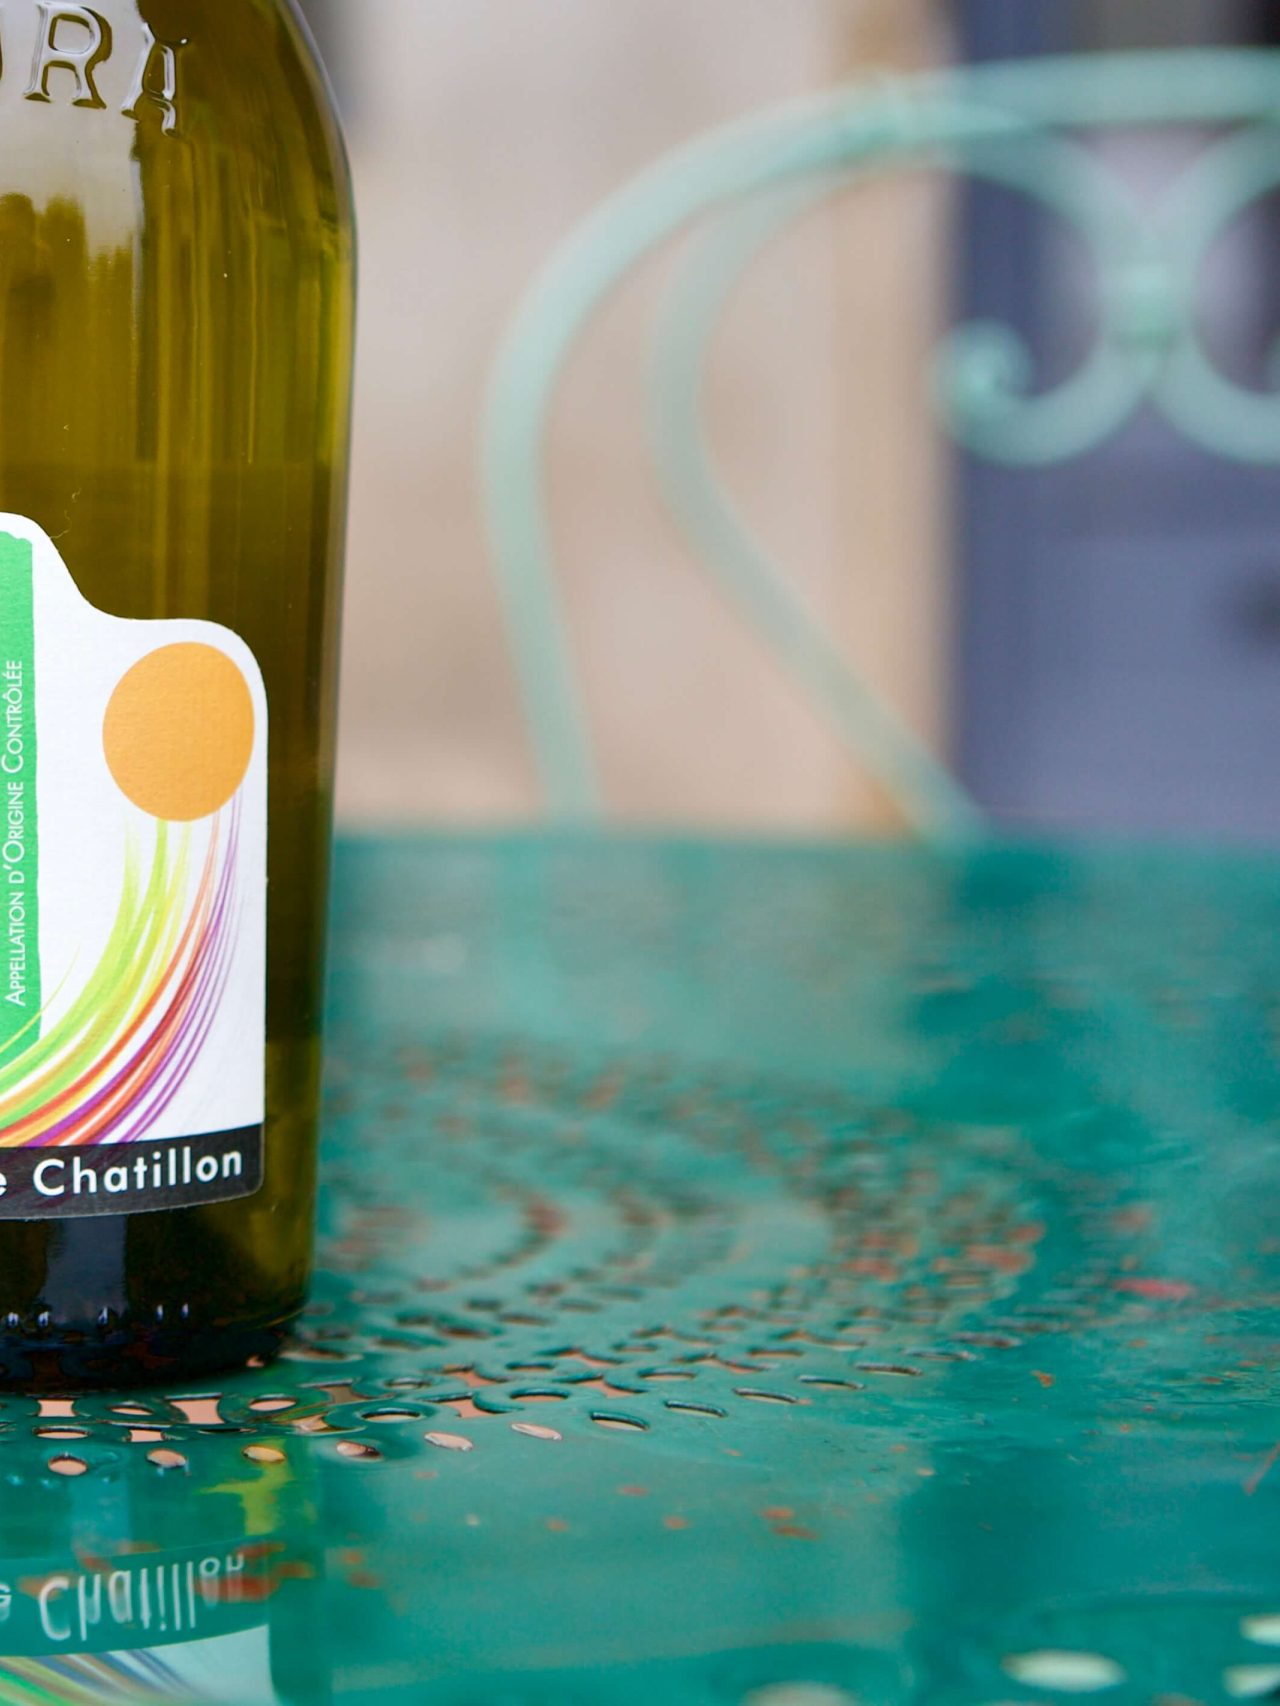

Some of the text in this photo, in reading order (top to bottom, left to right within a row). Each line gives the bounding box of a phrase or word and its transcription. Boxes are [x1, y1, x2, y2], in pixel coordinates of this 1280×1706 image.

[1, 660, 24, 774] CONTRÔLÉE
[4, 891, 27, 1007] APPELLATION
[32, 1145, 243, 1197] Chatillon
